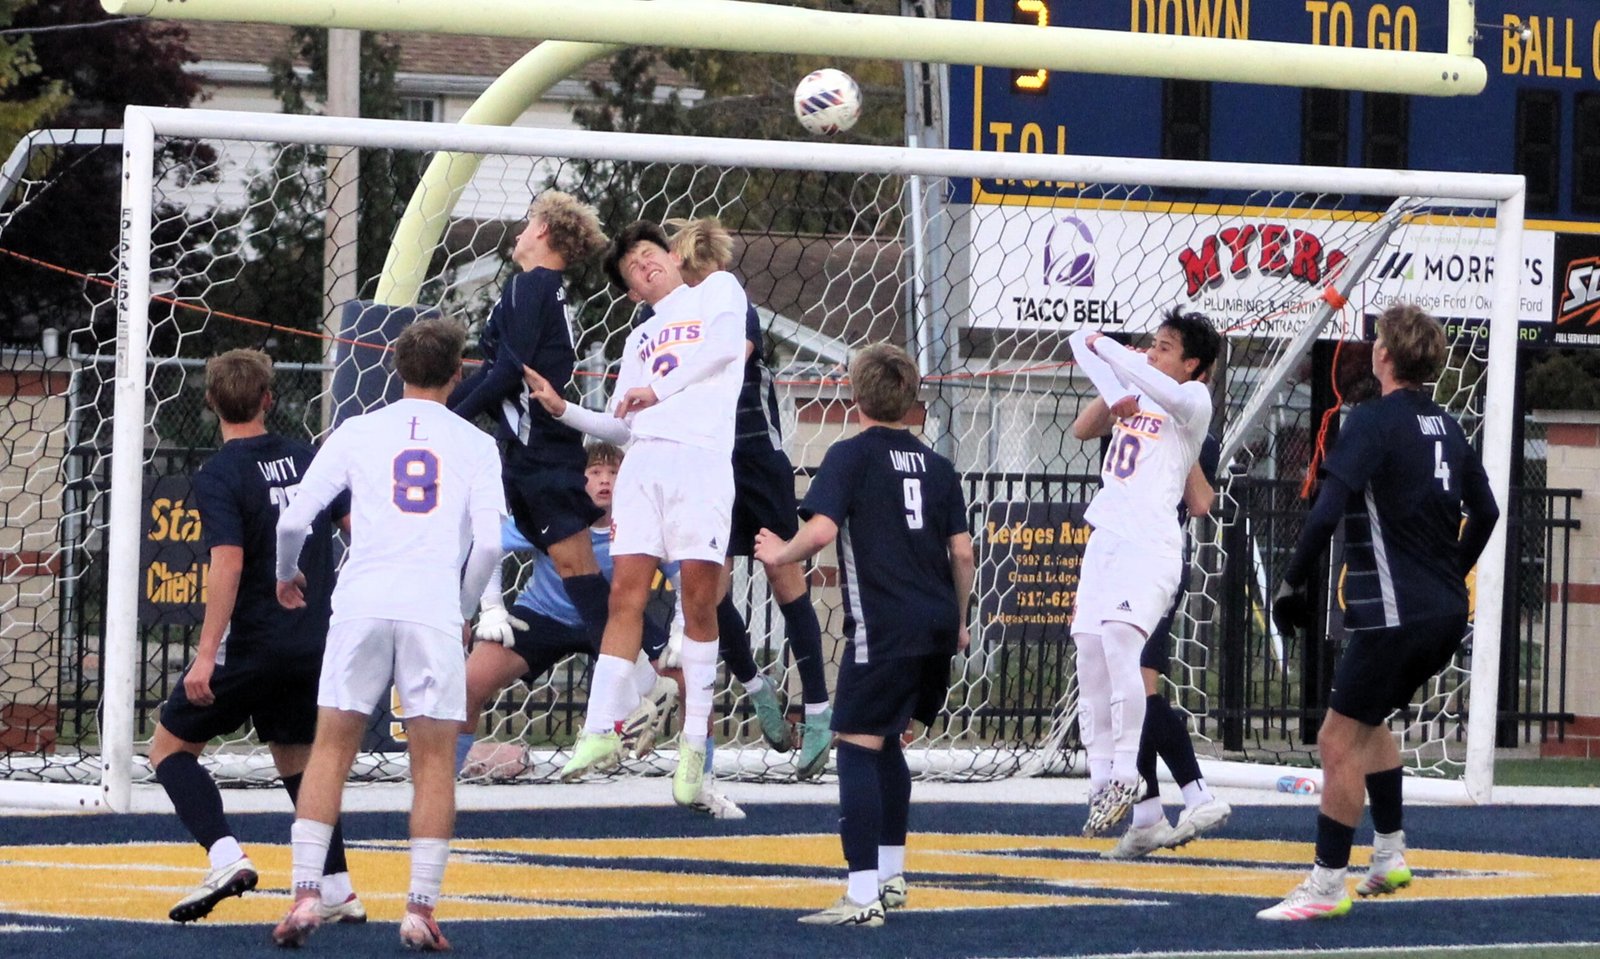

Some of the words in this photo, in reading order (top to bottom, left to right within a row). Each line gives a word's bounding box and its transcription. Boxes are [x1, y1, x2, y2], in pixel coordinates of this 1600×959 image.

[1131, 0, 1248, 40] DOWN
[1306, 1, 1353, 48] TO
[1367, 4, 1417, 52] GO
[1502, 13, 1582, 79] BALL
[1013, 298, 1068, 322] TACO
[1074, 299, 1123, 324] BELL
[1204, 299, 1264, 313] PLUMBING
[1282, 301, 1319, 316] HEATIN
[1520, 298, 1543, 312] Ford
[257, 456, 297, 482] UNITY
[889, 449, 926, 472] UNITY
[1434, 441, 1450, 491] 4
[393, 448, 440, 515] 8
[903, 478, 923, 529] 9
[987, 521, 1054, 551] Ledges
[1060, 521, 1091, 544] Aut
[147, 561, 197, 604] Cheri
[1008, 571, 1042, 583] Grand
